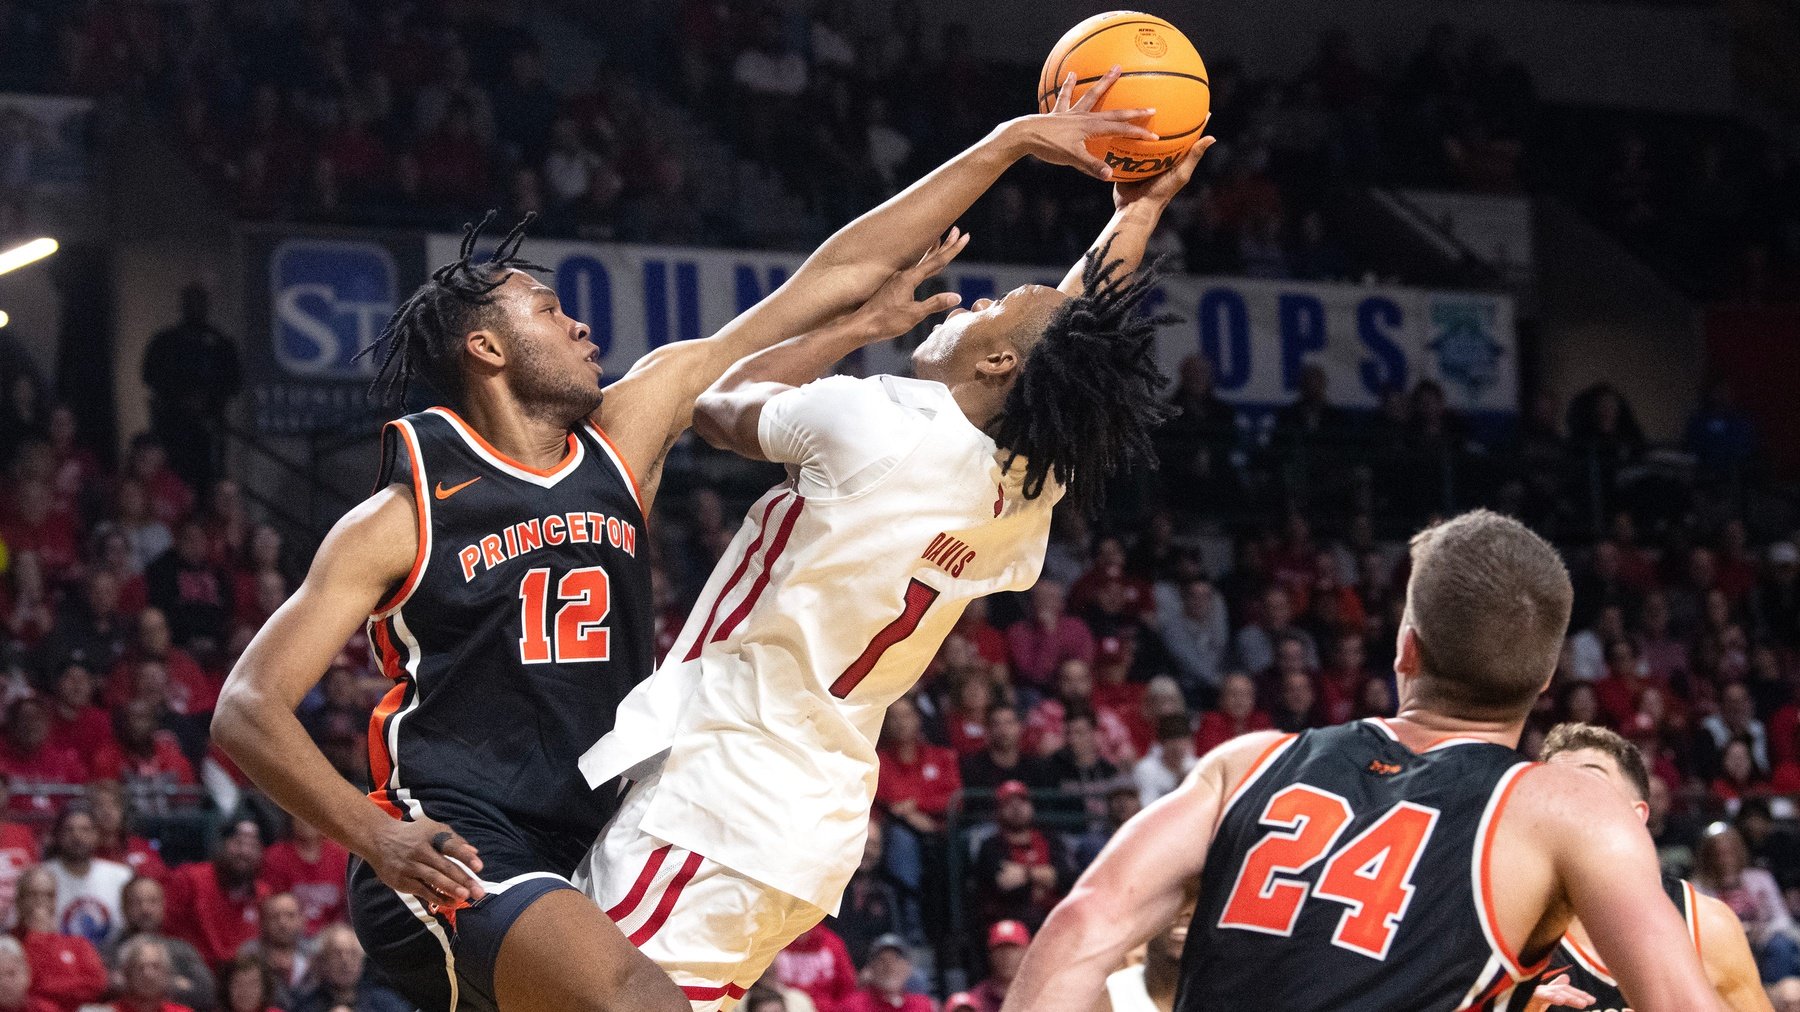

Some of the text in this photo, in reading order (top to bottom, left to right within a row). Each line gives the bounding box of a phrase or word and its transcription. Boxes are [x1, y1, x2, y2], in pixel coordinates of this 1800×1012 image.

[1104, 151, 1182, 173] NCAA
[458, 511, 636, 584] PRINCETON
[921, 531, 977, 579] DAVIS
[518, 565, 611, 665] 12
[828, 576, 941, 700] 1
[1216, 781, 1441, 961] 24
